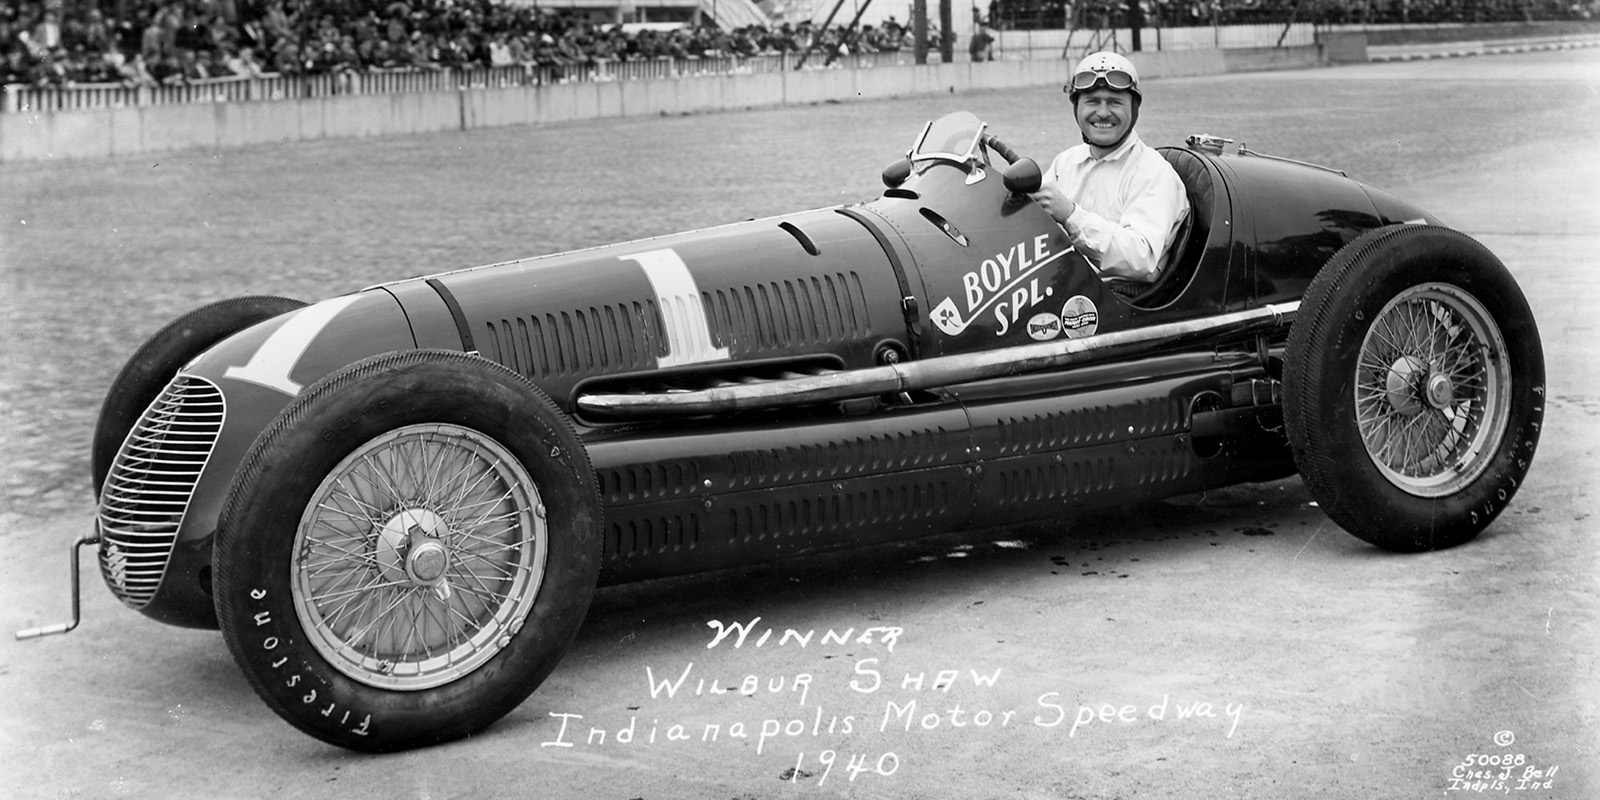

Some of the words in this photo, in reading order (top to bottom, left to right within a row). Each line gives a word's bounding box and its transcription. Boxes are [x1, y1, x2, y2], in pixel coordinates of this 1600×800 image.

[617, 248, 730, 369] 1
[962, 233, 1051, 313] BOYLE
[994, 277, 1054, 337] SPL.
[223, 292, 366, 397] 1
[250, 588, 371, 735] Firestone
